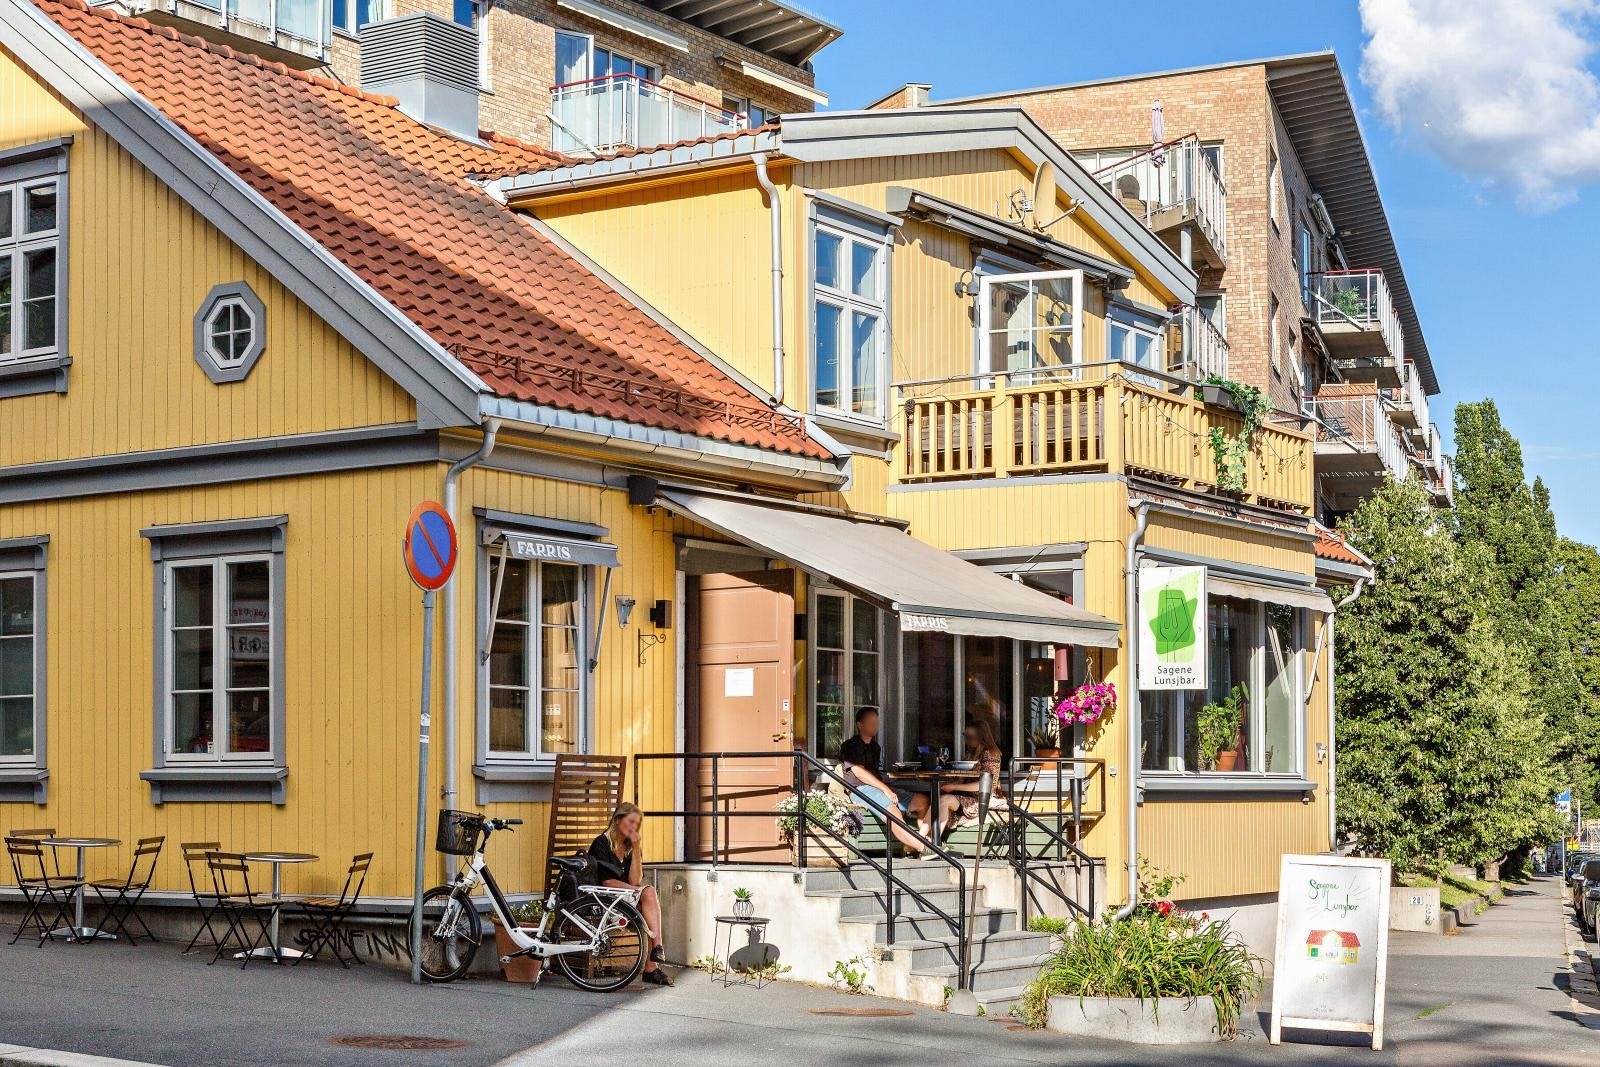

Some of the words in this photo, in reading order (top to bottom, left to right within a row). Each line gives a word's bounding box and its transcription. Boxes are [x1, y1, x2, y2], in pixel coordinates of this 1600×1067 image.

[517, 541, 571, 559] FARRIS
[1157, 665, 1193, 676] Sagene
[1154, 676, 1196, 686] Lunsjbar
